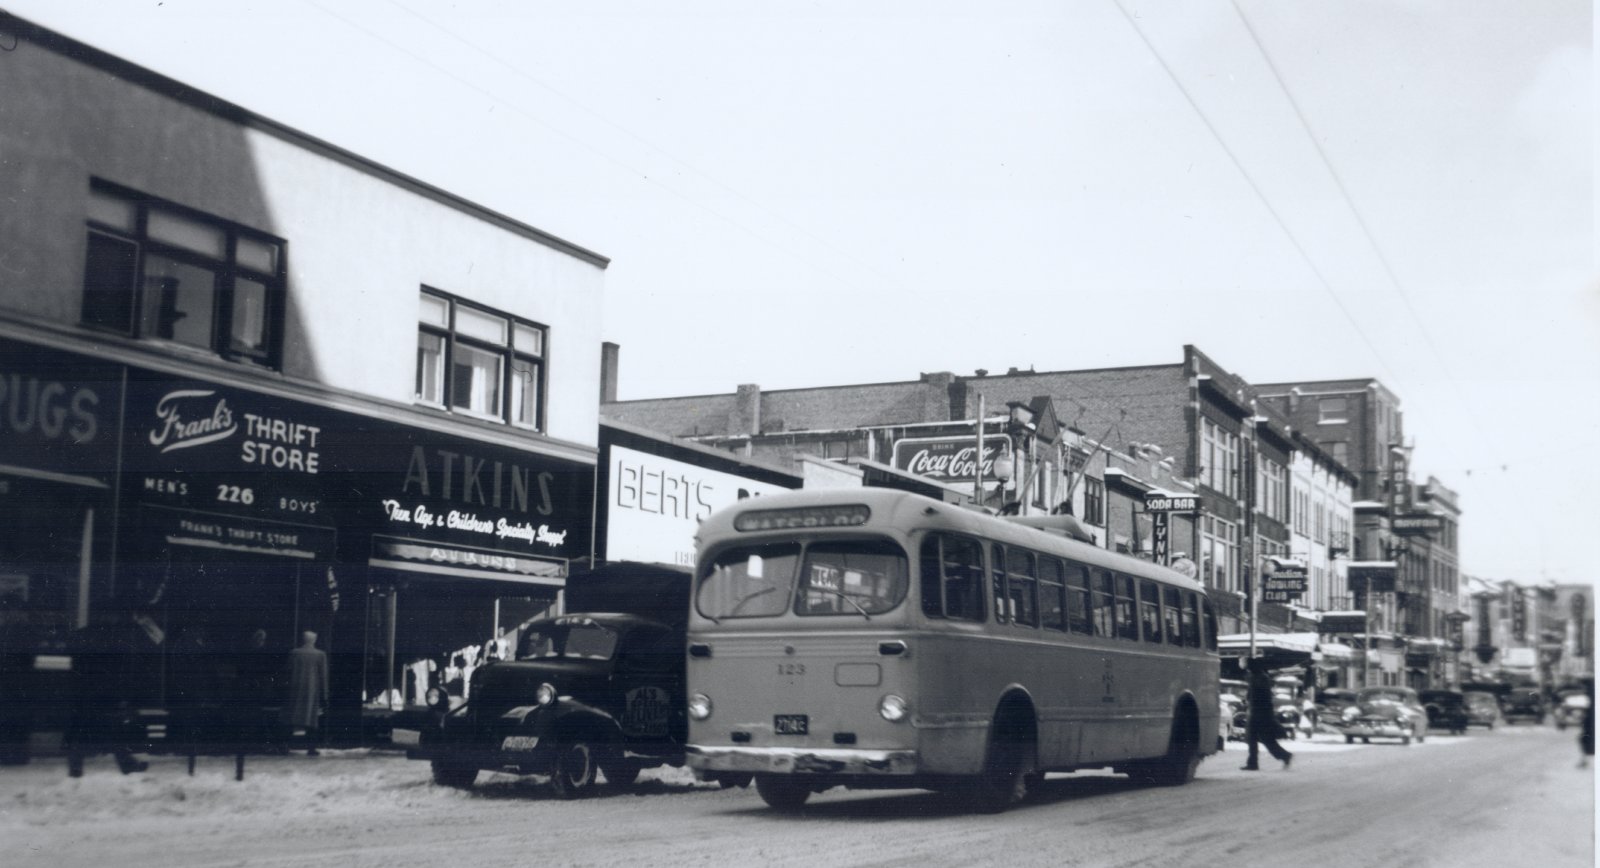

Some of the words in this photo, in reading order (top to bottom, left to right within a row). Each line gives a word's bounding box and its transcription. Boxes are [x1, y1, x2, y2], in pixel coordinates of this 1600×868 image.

[0, 373, 98, 443] UGS
[149, 389, 233, 446] Frank's
[244, 414, 320, 448] THRIFT
[241, 441, 319, 474] STORE
[145, 477, 188, 495] MEN'S
[217, 484, 254, 505] 226
[402, 445, 553, 515] ATKINS
[1394, 461, 1404, 515] HOTEL
[382, 499, 410, 523] Teen
[414, 505, 434, 530] Age
[436, 513, 444, 527] &
[495, 517, 536, 545] Specialty
[1146, 499, 1171, 510] SODA
[1173, 499, 1196, 509] BAR
[180, 520, 222, 538] FRANK'S
[228, 526, 262, 542] THRIFT
[267, 532, 298, 547] STORE
[778, 663, 807, 676] 123
